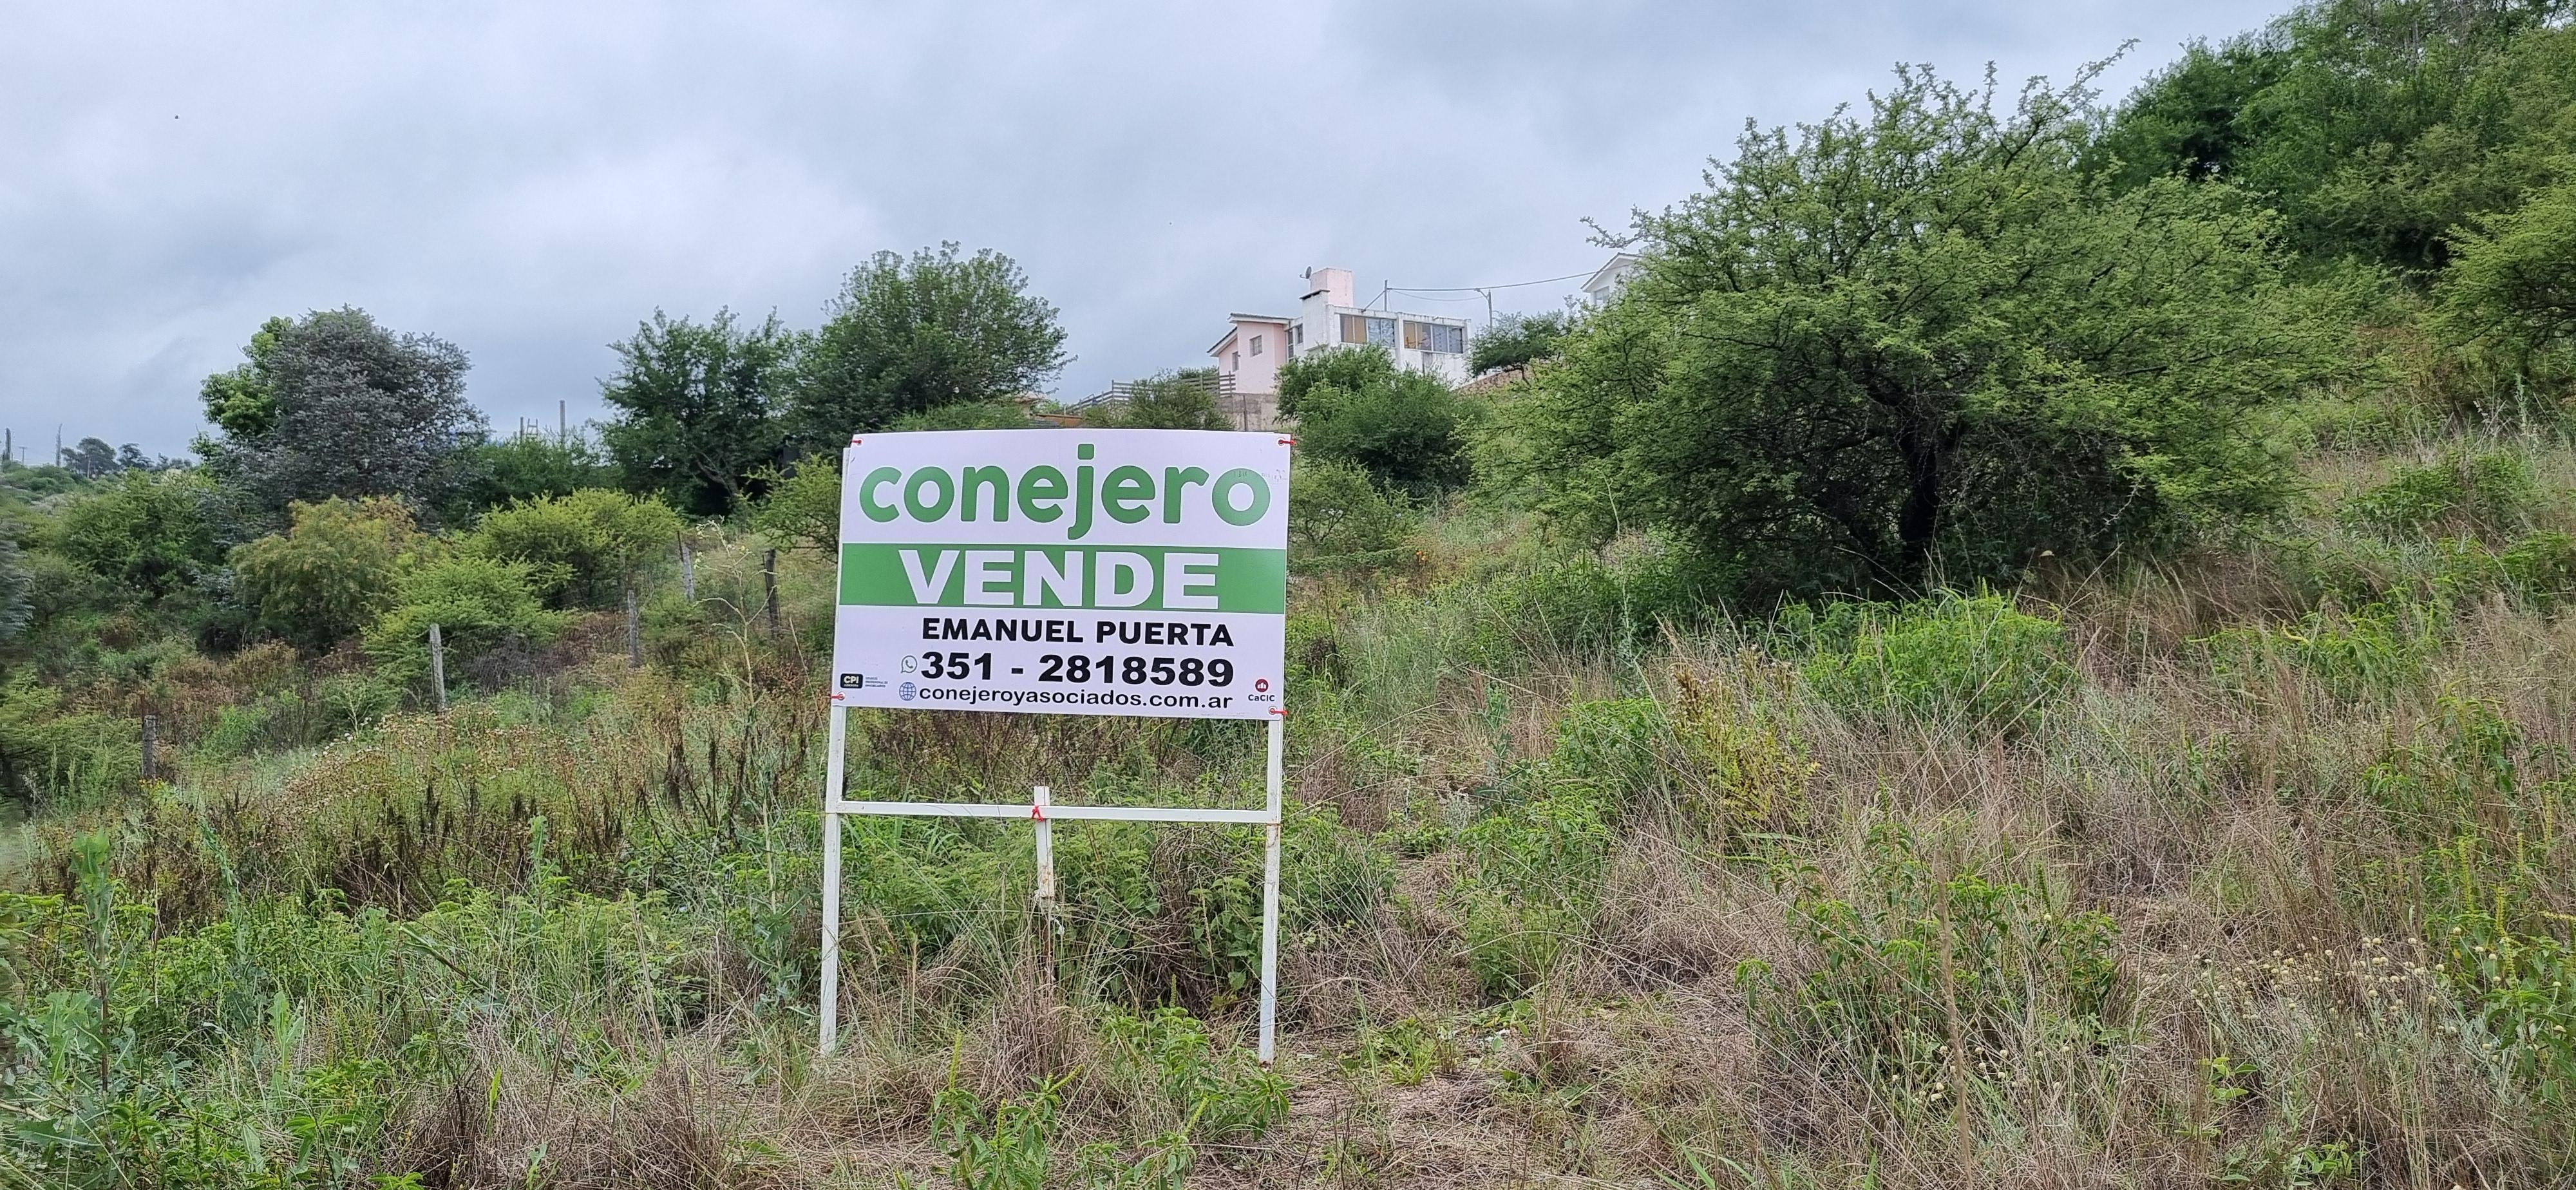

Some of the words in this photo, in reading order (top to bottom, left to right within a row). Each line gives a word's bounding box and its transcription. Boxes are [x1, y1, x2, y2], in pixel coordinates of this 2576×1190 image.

[860, 444, 1271, 540] conejero
[899, 549, 1219, 609] VENDE
[922, 618, 1083, 643] EMANUEL
[1096, 621, 1235, 647] PUERTA
[844, 675, 859, 684] CPI
[921, 652, 992, 681] 351
[1011, 666, 1024, 675] -
[1038, 654, 1234, 686] 2818589
[919, 685, 1233, 709] conejeroyasociados.com.ar
